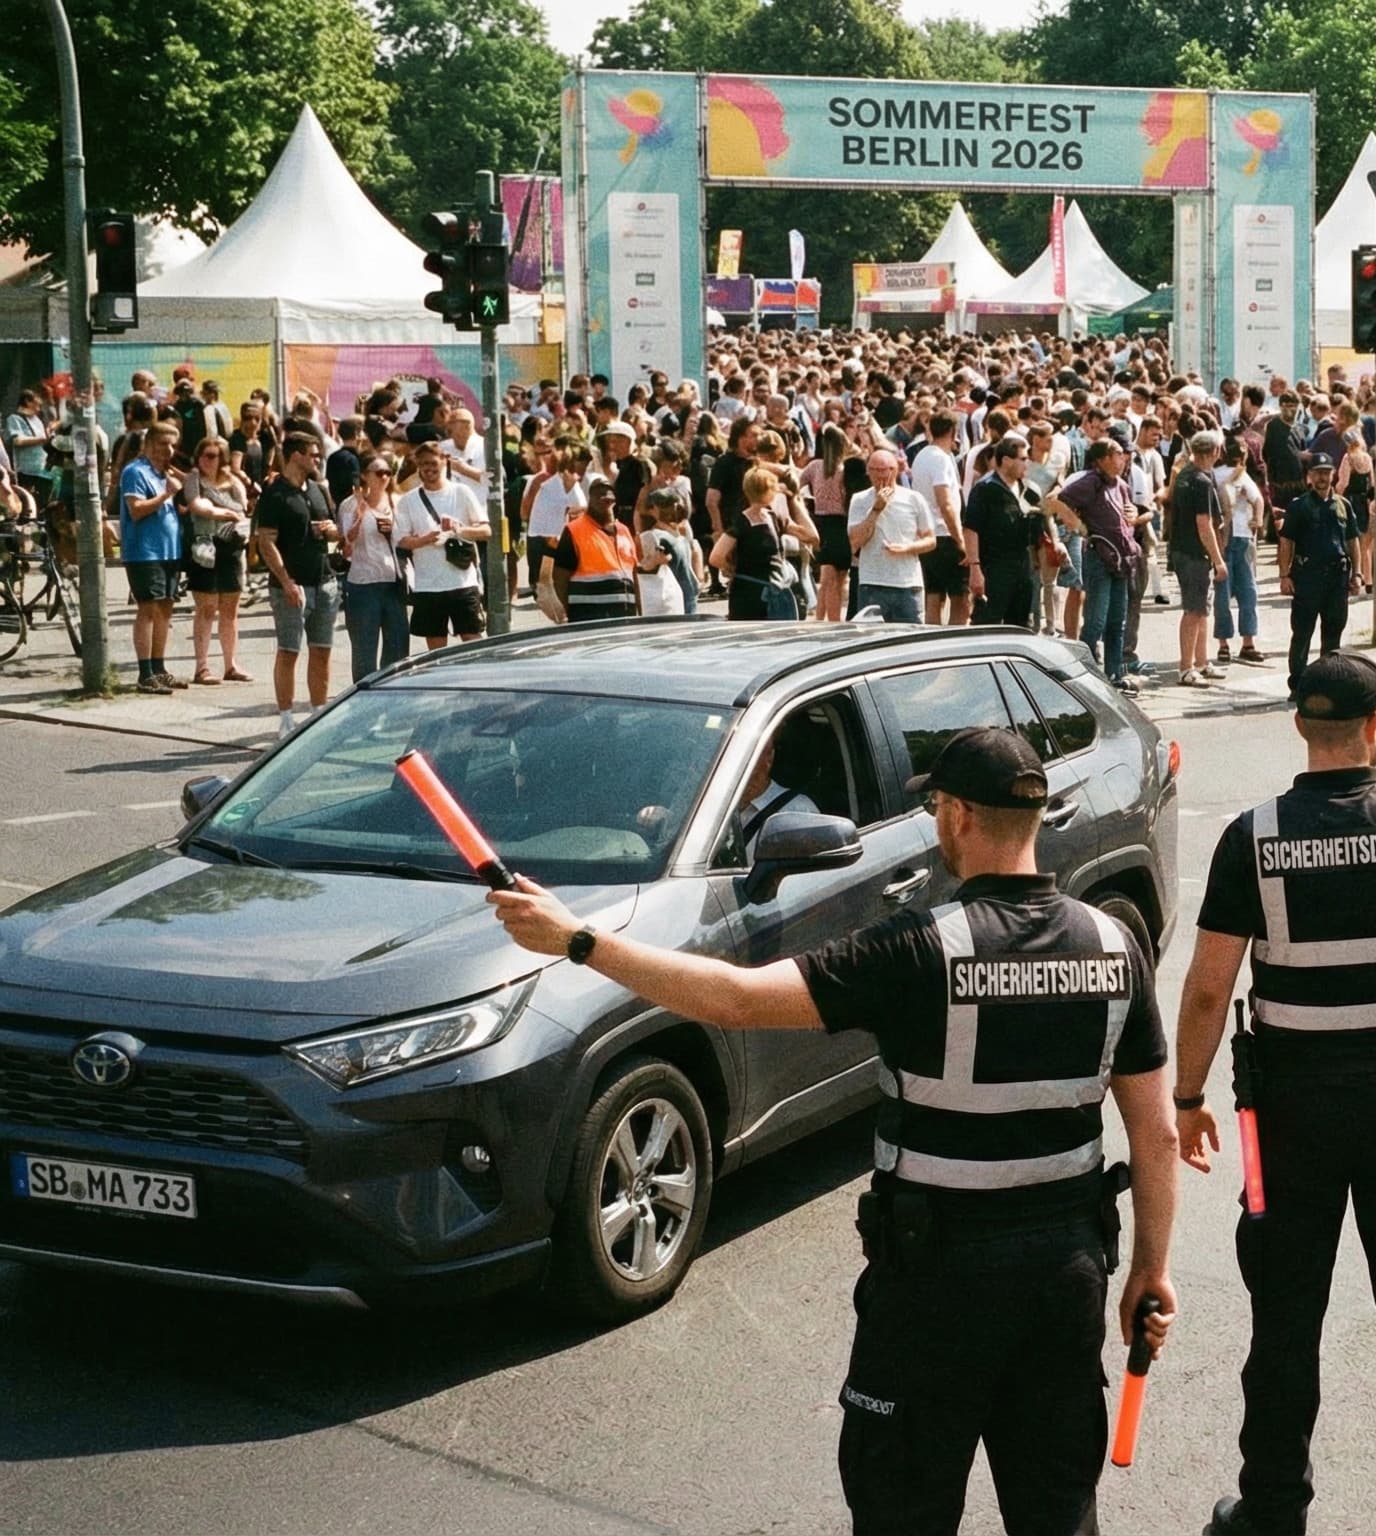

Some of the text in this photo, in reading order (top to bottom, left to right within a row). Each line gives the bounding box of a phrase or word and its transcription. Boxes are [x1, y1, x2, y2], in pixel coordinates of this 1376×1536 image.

[828, 97, 1095, 133] SOMMERFEST
[842, 135, 1084, 171] BERLIN 2026
[955, 959, 1125, 997] SICHERHEITSDIENST
[30, 1161, 69, 1196] SB
[87, 1168, 127, 1204] MA
[133, 1174, 190, 1212] 733
